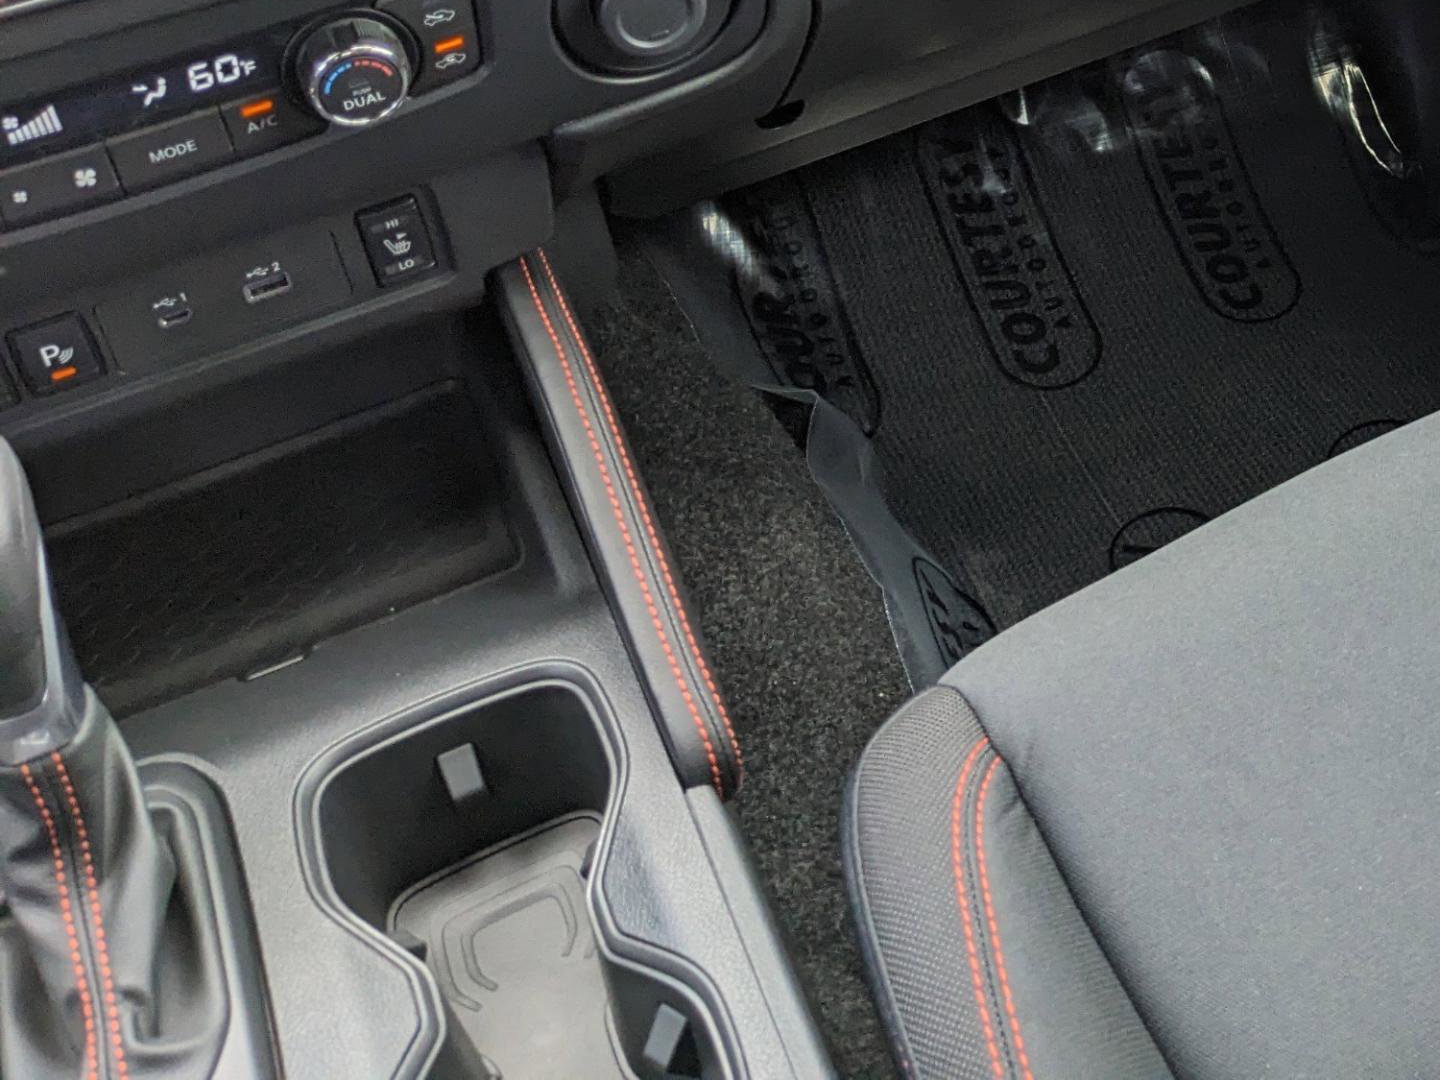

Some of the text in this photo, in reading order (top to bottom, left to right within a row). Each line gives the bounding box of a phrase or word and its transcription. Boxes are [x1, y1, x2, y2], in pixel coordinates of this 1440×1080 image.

[343, 91, 386, 111] DUAL
[248, 114, 278, 134] A/C
[149, 139, 198, 164] MODE
[385, 218, 399, 230] HI
[271, 261, 281, 272] 2
[398, 258, 415, 271] LO
[39, 344, 60, 367] P
